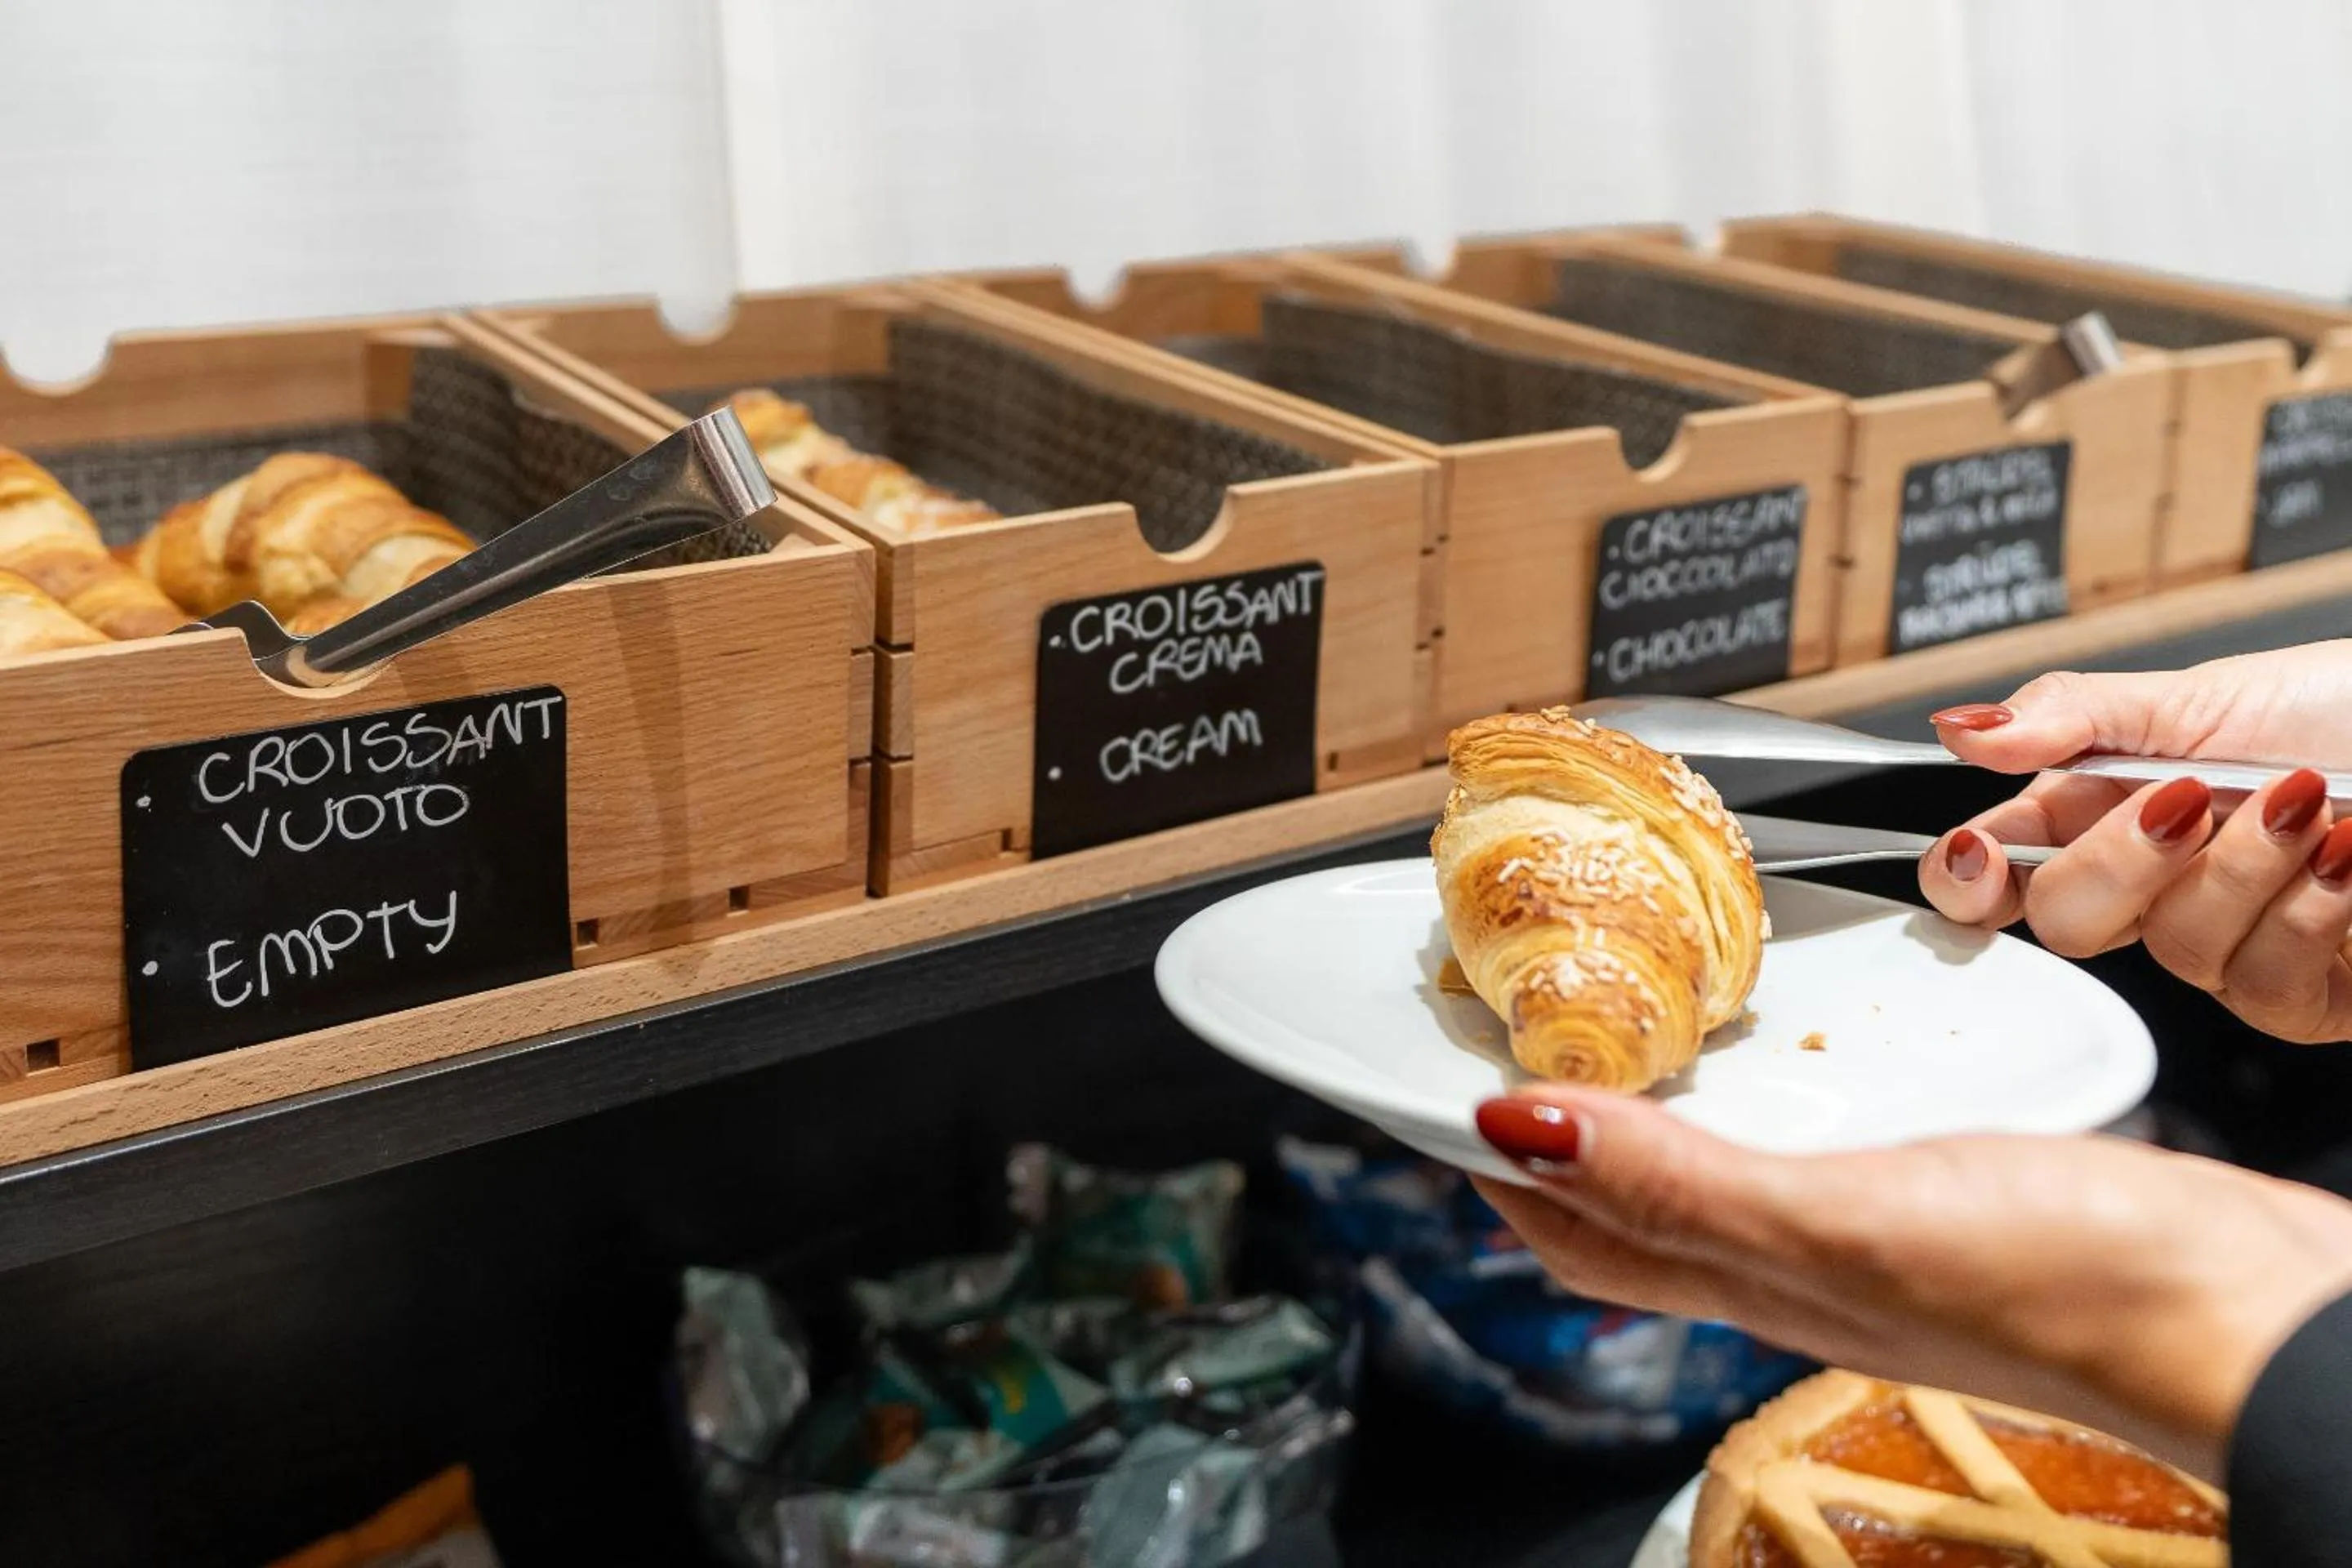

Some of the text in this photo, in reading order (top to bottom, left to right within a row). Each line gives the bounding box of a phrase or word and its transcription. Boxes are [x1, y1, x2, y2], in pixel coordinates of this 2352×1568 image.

[1070, 570, 1325, 653] CROISSANT
[1109, 631, 1263, 693] CREMA
[198, 695, 563, 803] CROISSANT
[1100, 709, 1263, 783] CREAM
[221, 783, 469, 858] VUOTO
[207, 890, 457, 1008] EMPTY
